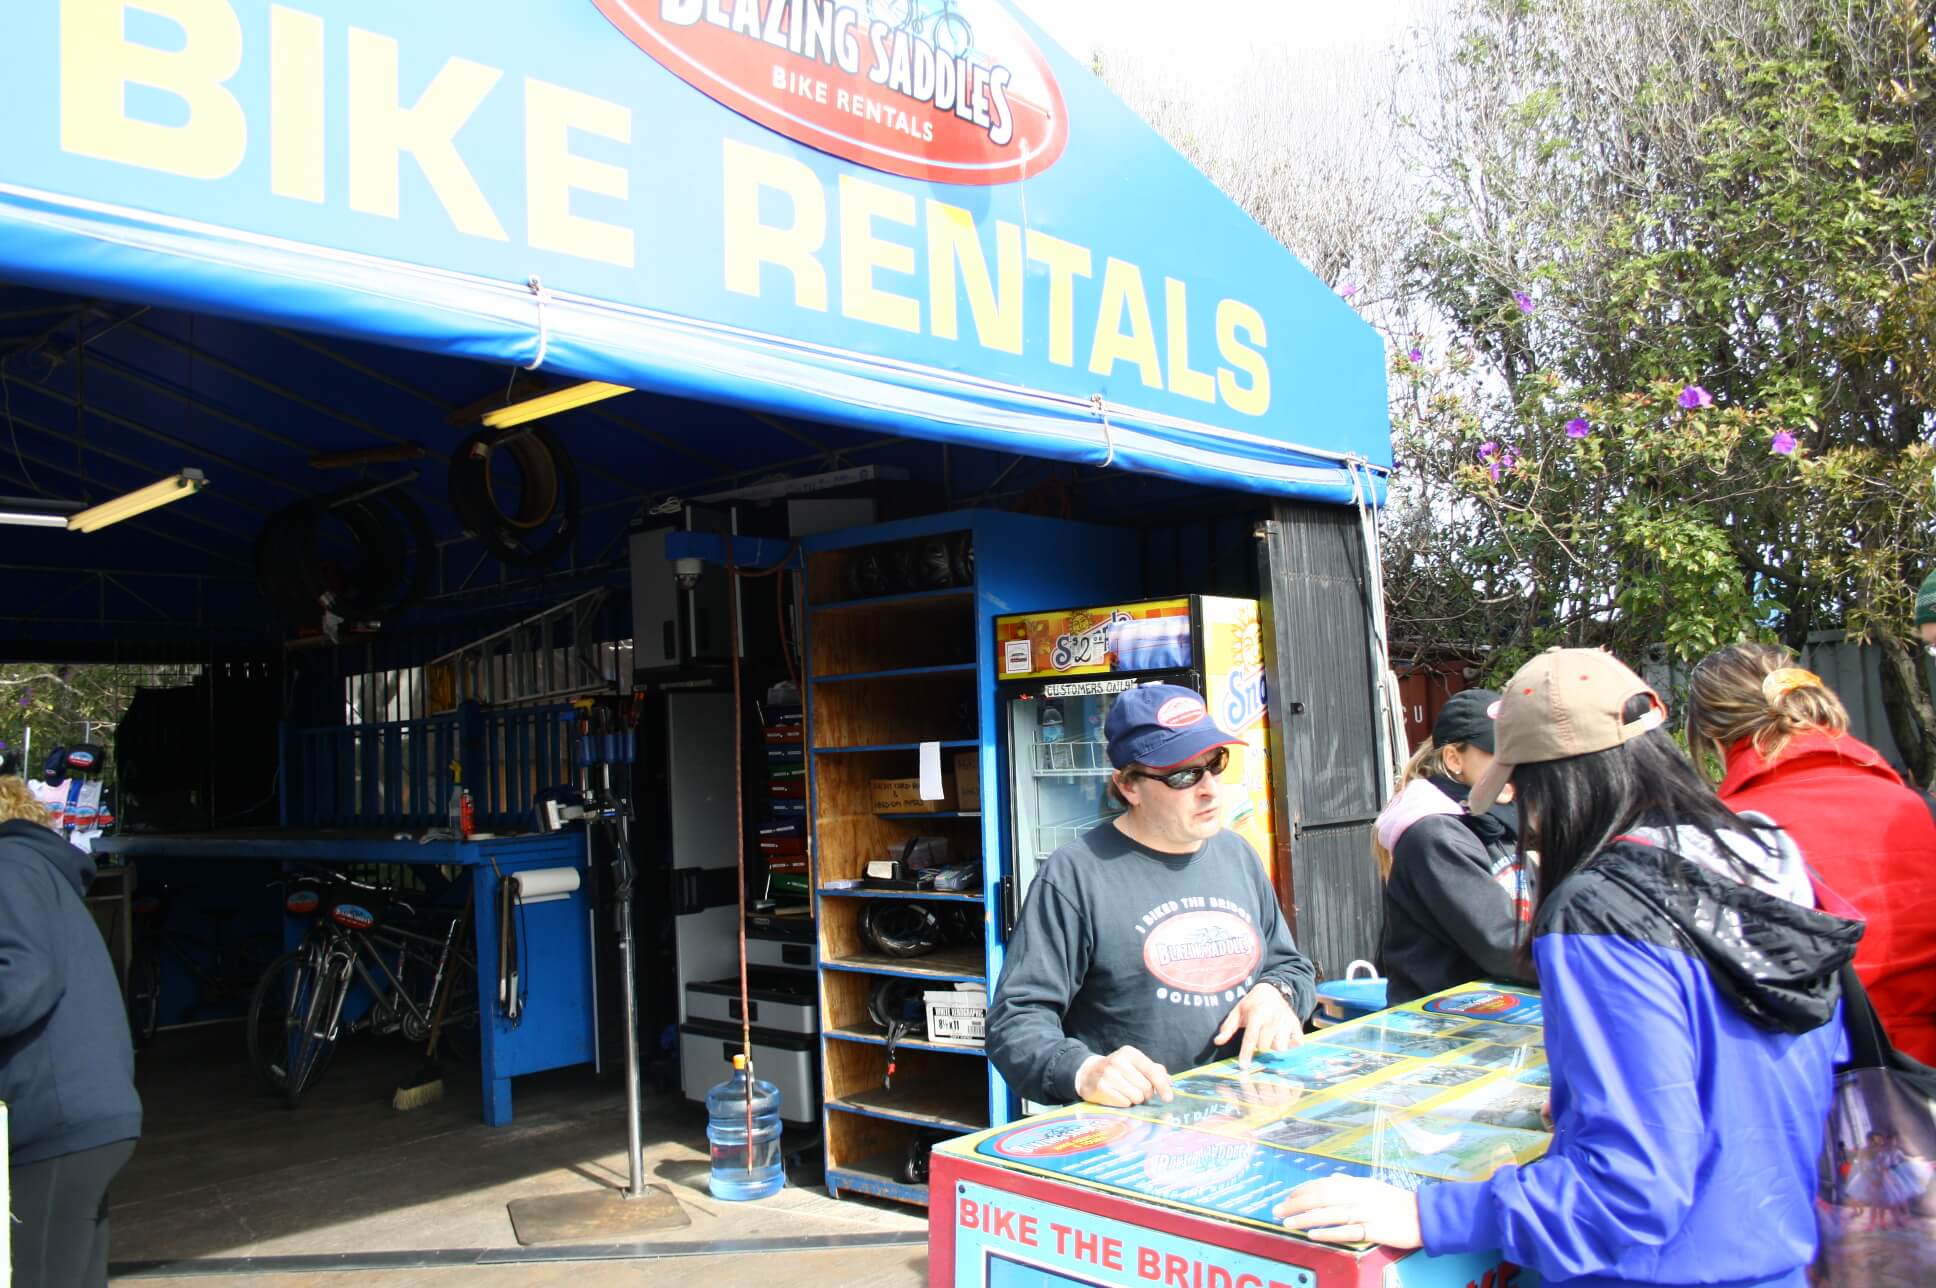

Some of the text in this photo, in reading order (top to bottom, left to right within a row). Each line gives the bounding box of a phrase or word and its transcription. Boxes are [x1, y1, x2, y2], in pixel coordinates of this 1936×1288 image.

[772, 65, 935, 143] BIKE RENTALS
[868, 21, 1014, 146] SADDLES
[59, 0, 1271, 417] BIKE RENTALS
[1047, 684, 1104, 697] CUSTOMERS
[1181, 896, 1206, 910] THE
[959, 1197, 1039, 1247] BIKE
[1049, 1222, 1124, 1272] THE
